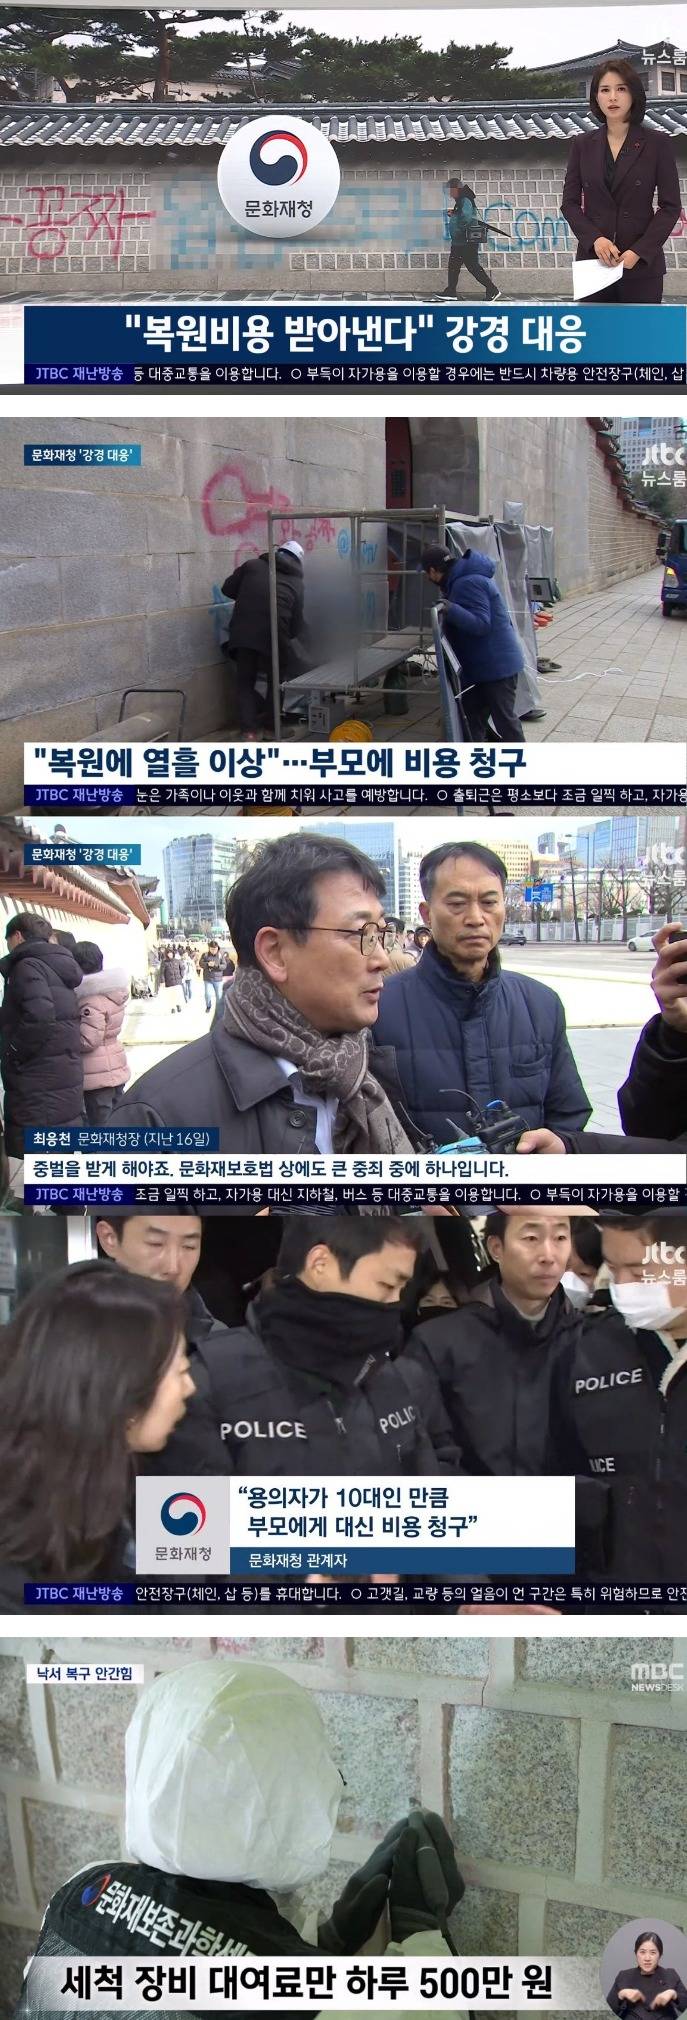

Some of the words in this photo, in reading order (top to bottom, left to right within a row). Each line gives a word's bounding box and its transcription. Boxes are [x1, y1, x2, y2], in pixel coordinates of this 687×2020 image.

[575, 1368, 643, 1394] POLICE
[220, 1420, 308, 1440] POLICE
[379, 1405, 416, 1434] POLIC
